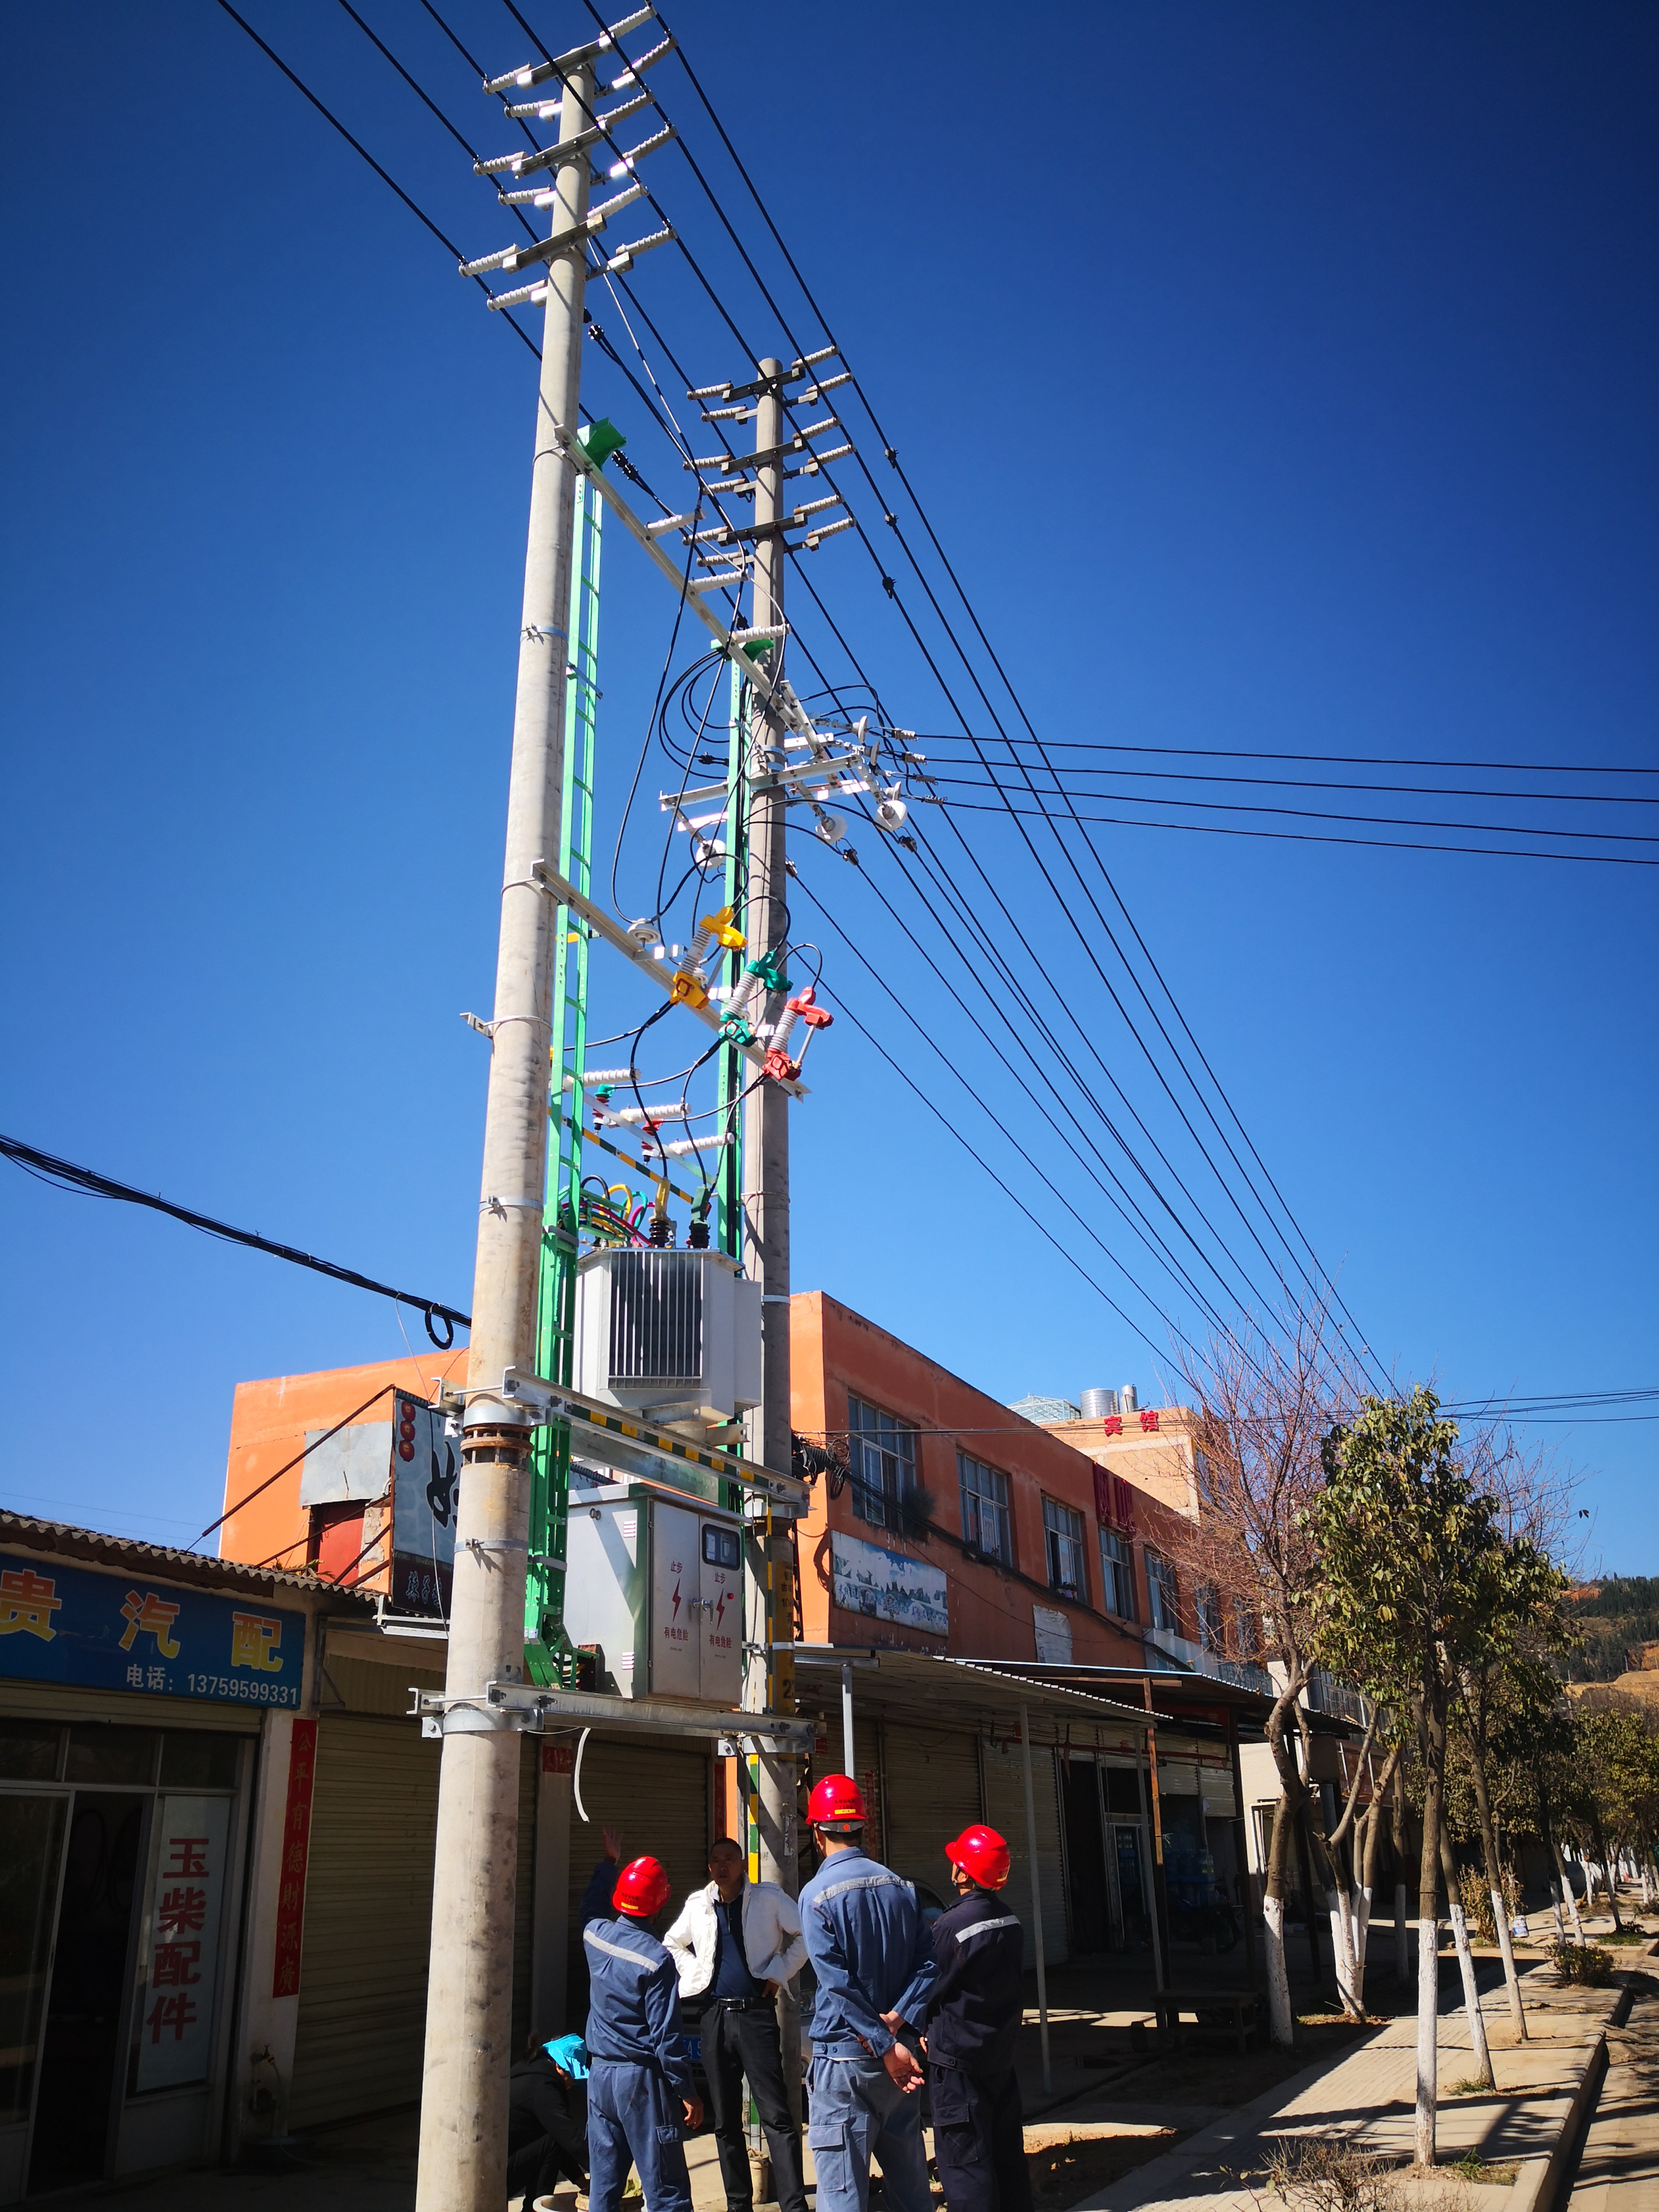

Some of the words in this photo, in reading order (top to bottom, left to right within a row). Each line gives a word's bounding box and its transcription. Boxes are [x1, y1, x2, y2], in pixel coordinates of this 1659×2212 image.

[1104, 1410, 1159, 1437] 宾馆
[671, 1560, 683, 1573] 止步
[715, 1572, 726, 1584] 止步
[664, 1627, 689, 1641] 有电危险
[709, 1634, 732, 1648] 有电危险
[126, 1663, 173, 1691] 电话：
[188, 1673, 298, 1705] 13759599331
[146, 1838, 210, 2044] 玉柴配件
